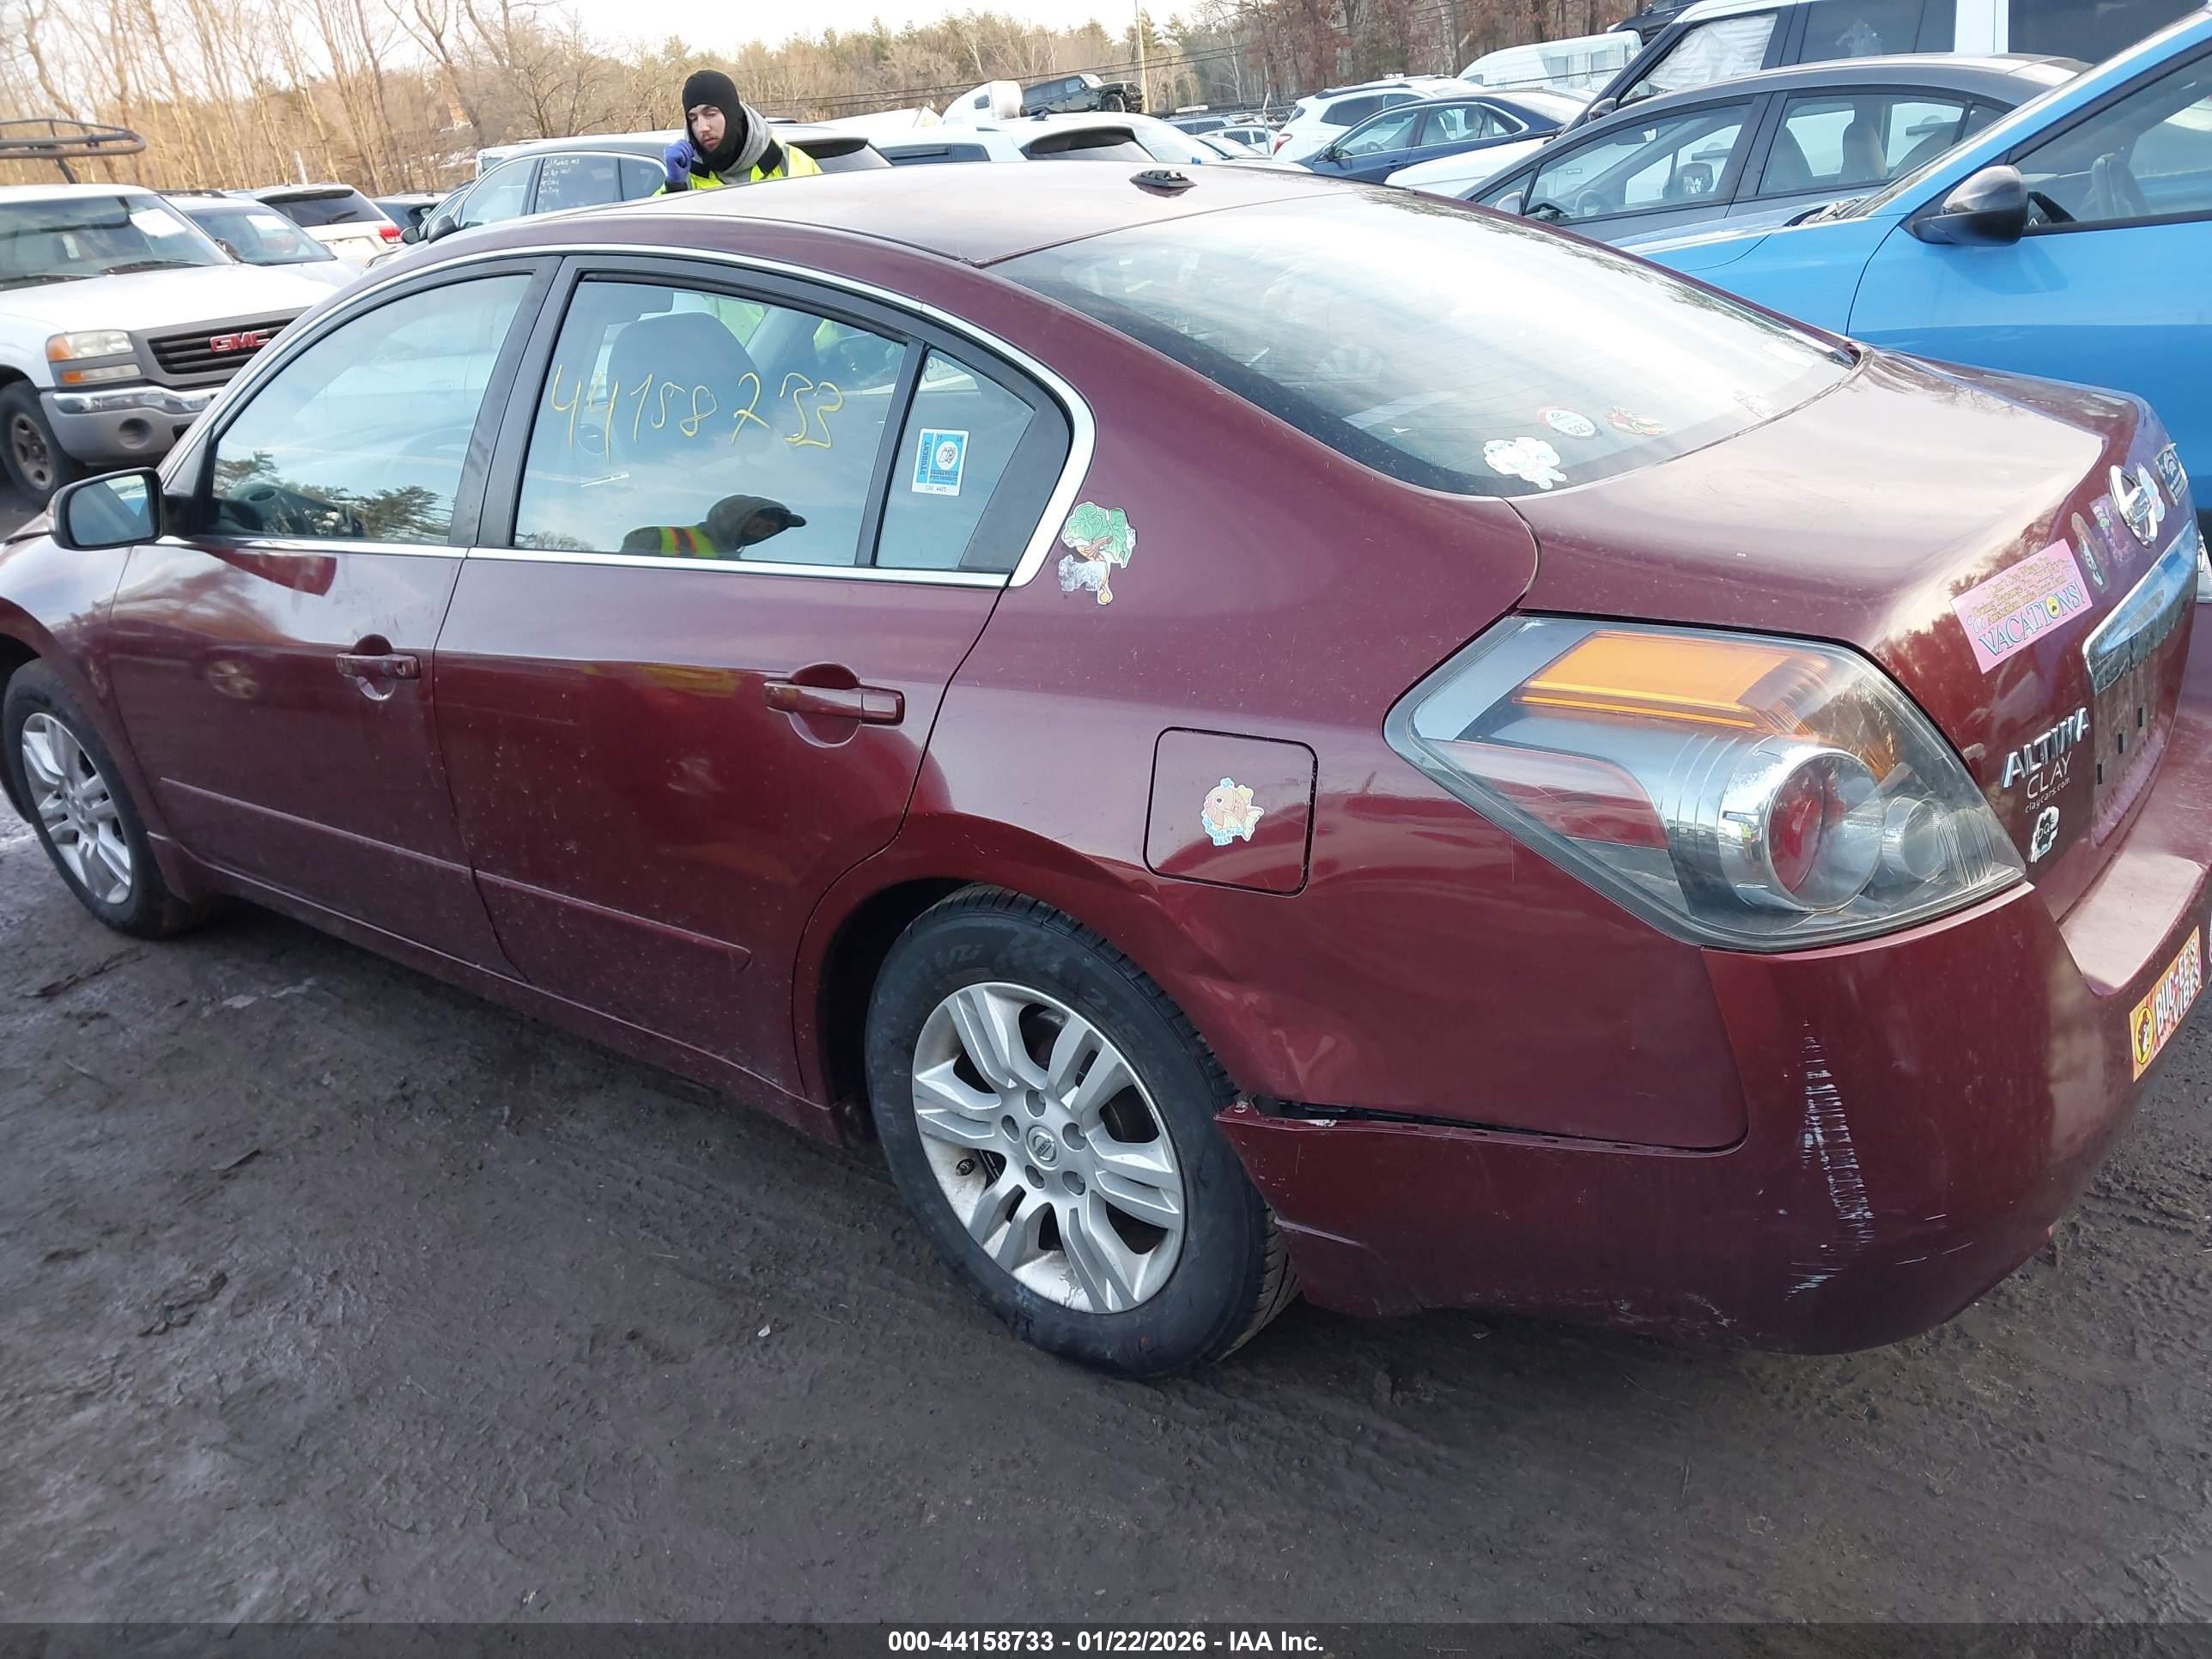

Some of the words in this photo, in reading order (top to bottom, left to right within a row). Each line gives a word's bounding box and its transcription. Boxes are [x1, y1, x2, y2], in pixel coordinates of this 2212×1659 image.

[210, 329, 270, 352] GMC
[920, 441, 931, 475] STUDENT
[1978, 579, 2086, 657] VACATIONS!
[2025, 777, 2070, 813] claycars.com
[2027, 750, 2072, 799] CLAY
[2173, 957, 2199, 1024] VIBES
